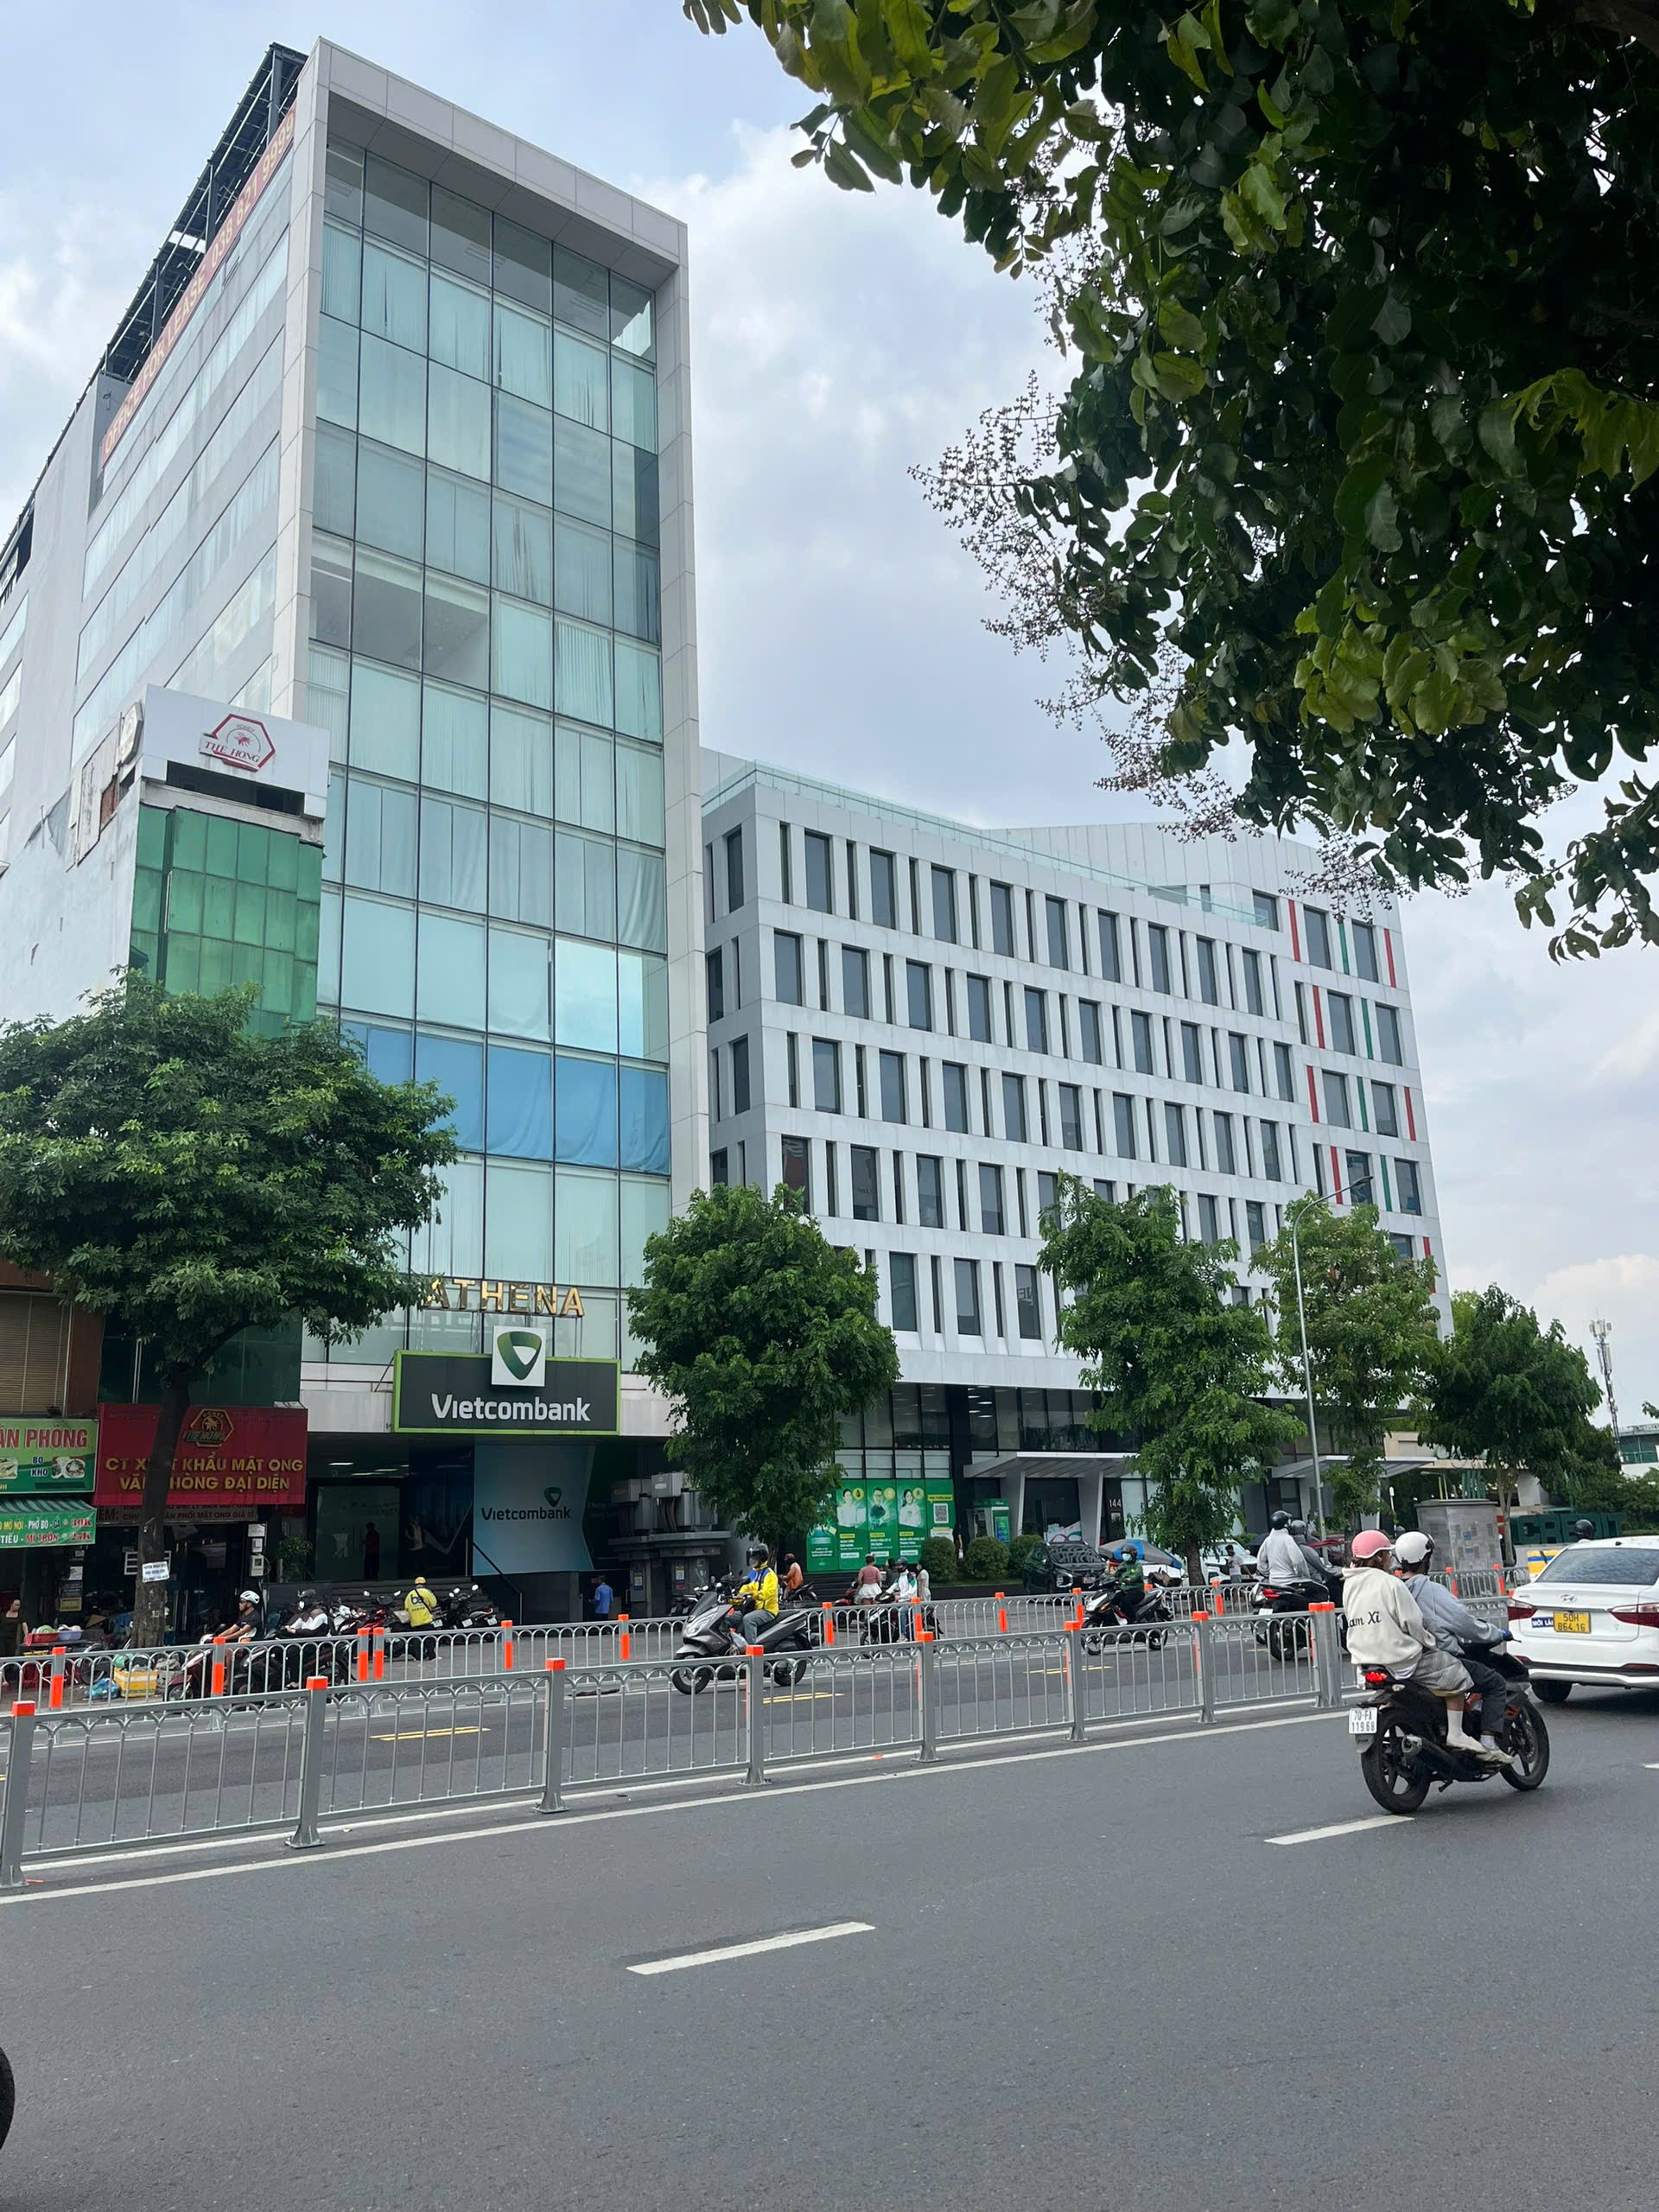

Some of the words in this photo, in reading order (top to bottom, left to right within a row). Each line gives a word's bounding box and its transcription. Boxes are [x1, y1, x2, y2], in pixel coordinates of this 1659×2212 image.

[105, 378, 141, 454] OFFICE
[143, 336, 166, 392] FOR
[167, 264, 207, 349] LEASE
[211, 217, 232, 268] 038
[236, 173, 258, 227] 821
[262, 112, 295, 181] 9999
[206, 741, 227, 753] THE
[231, 748, 260, 762] HONG
[423, 1278, 586, 1317] ATHENA
[431, 1393, 591, 1421] Vietcombank
[26, 1424, 88, 1448] PHÒNG
[182, 1452, 226, 1471] KHẨU
[232, 1455, 264, 1474] MẬT
[269, 1459, 303, 1471] ONG
[169, 1472, 219, 1490] HÒNG
[224, 1476, 251, 1492] ĐẠI
[257, 1473, 290, 1492] DIỆN
[481, 1506, 571, 1521] Vietcombank
[1109, 1499, 1122, 1508] 144
[1348, 1617, 1365, 1628] am
[1368, 1611, 1382, 1625] Xi
[1563, 1612, 1580, 1623] 50H
